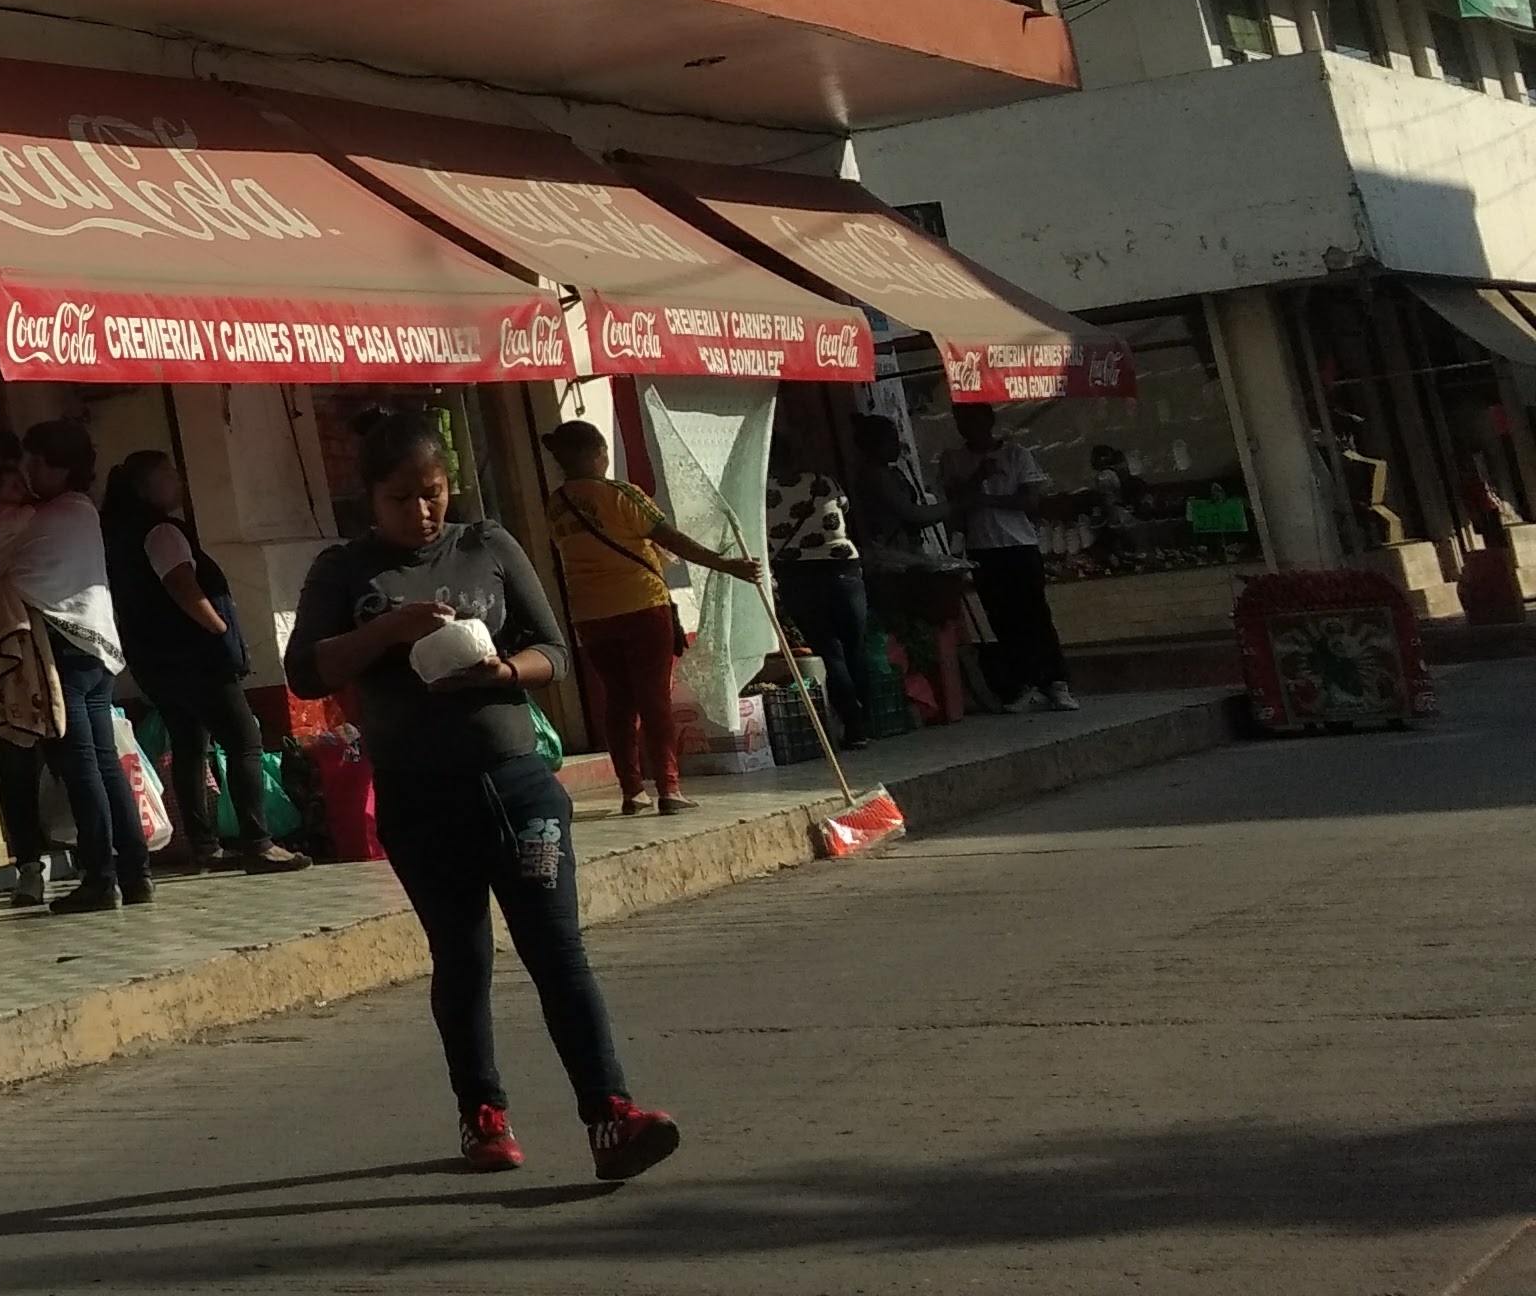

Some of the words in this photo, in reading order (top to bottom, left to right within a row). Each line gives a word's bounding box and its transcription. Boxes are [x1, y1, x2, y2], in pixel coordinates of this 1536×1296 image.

[6, 301, 98, 365] Coca-Cola
[104, 315, 206, 361] CREMERIA
[201, 320, 219, 361] Y
[219, 320, 293, 363] CARNES
[293, 322, 345, 364] FRIAS
[499, 314, 564, 368] Coca-Cola
[664, 307, 722, 337] CREMERIA
[721, 310, 730, 338] Y
[731, 312, 773, 341] CARNES
[774, 314, 805, 342] FRIAS
